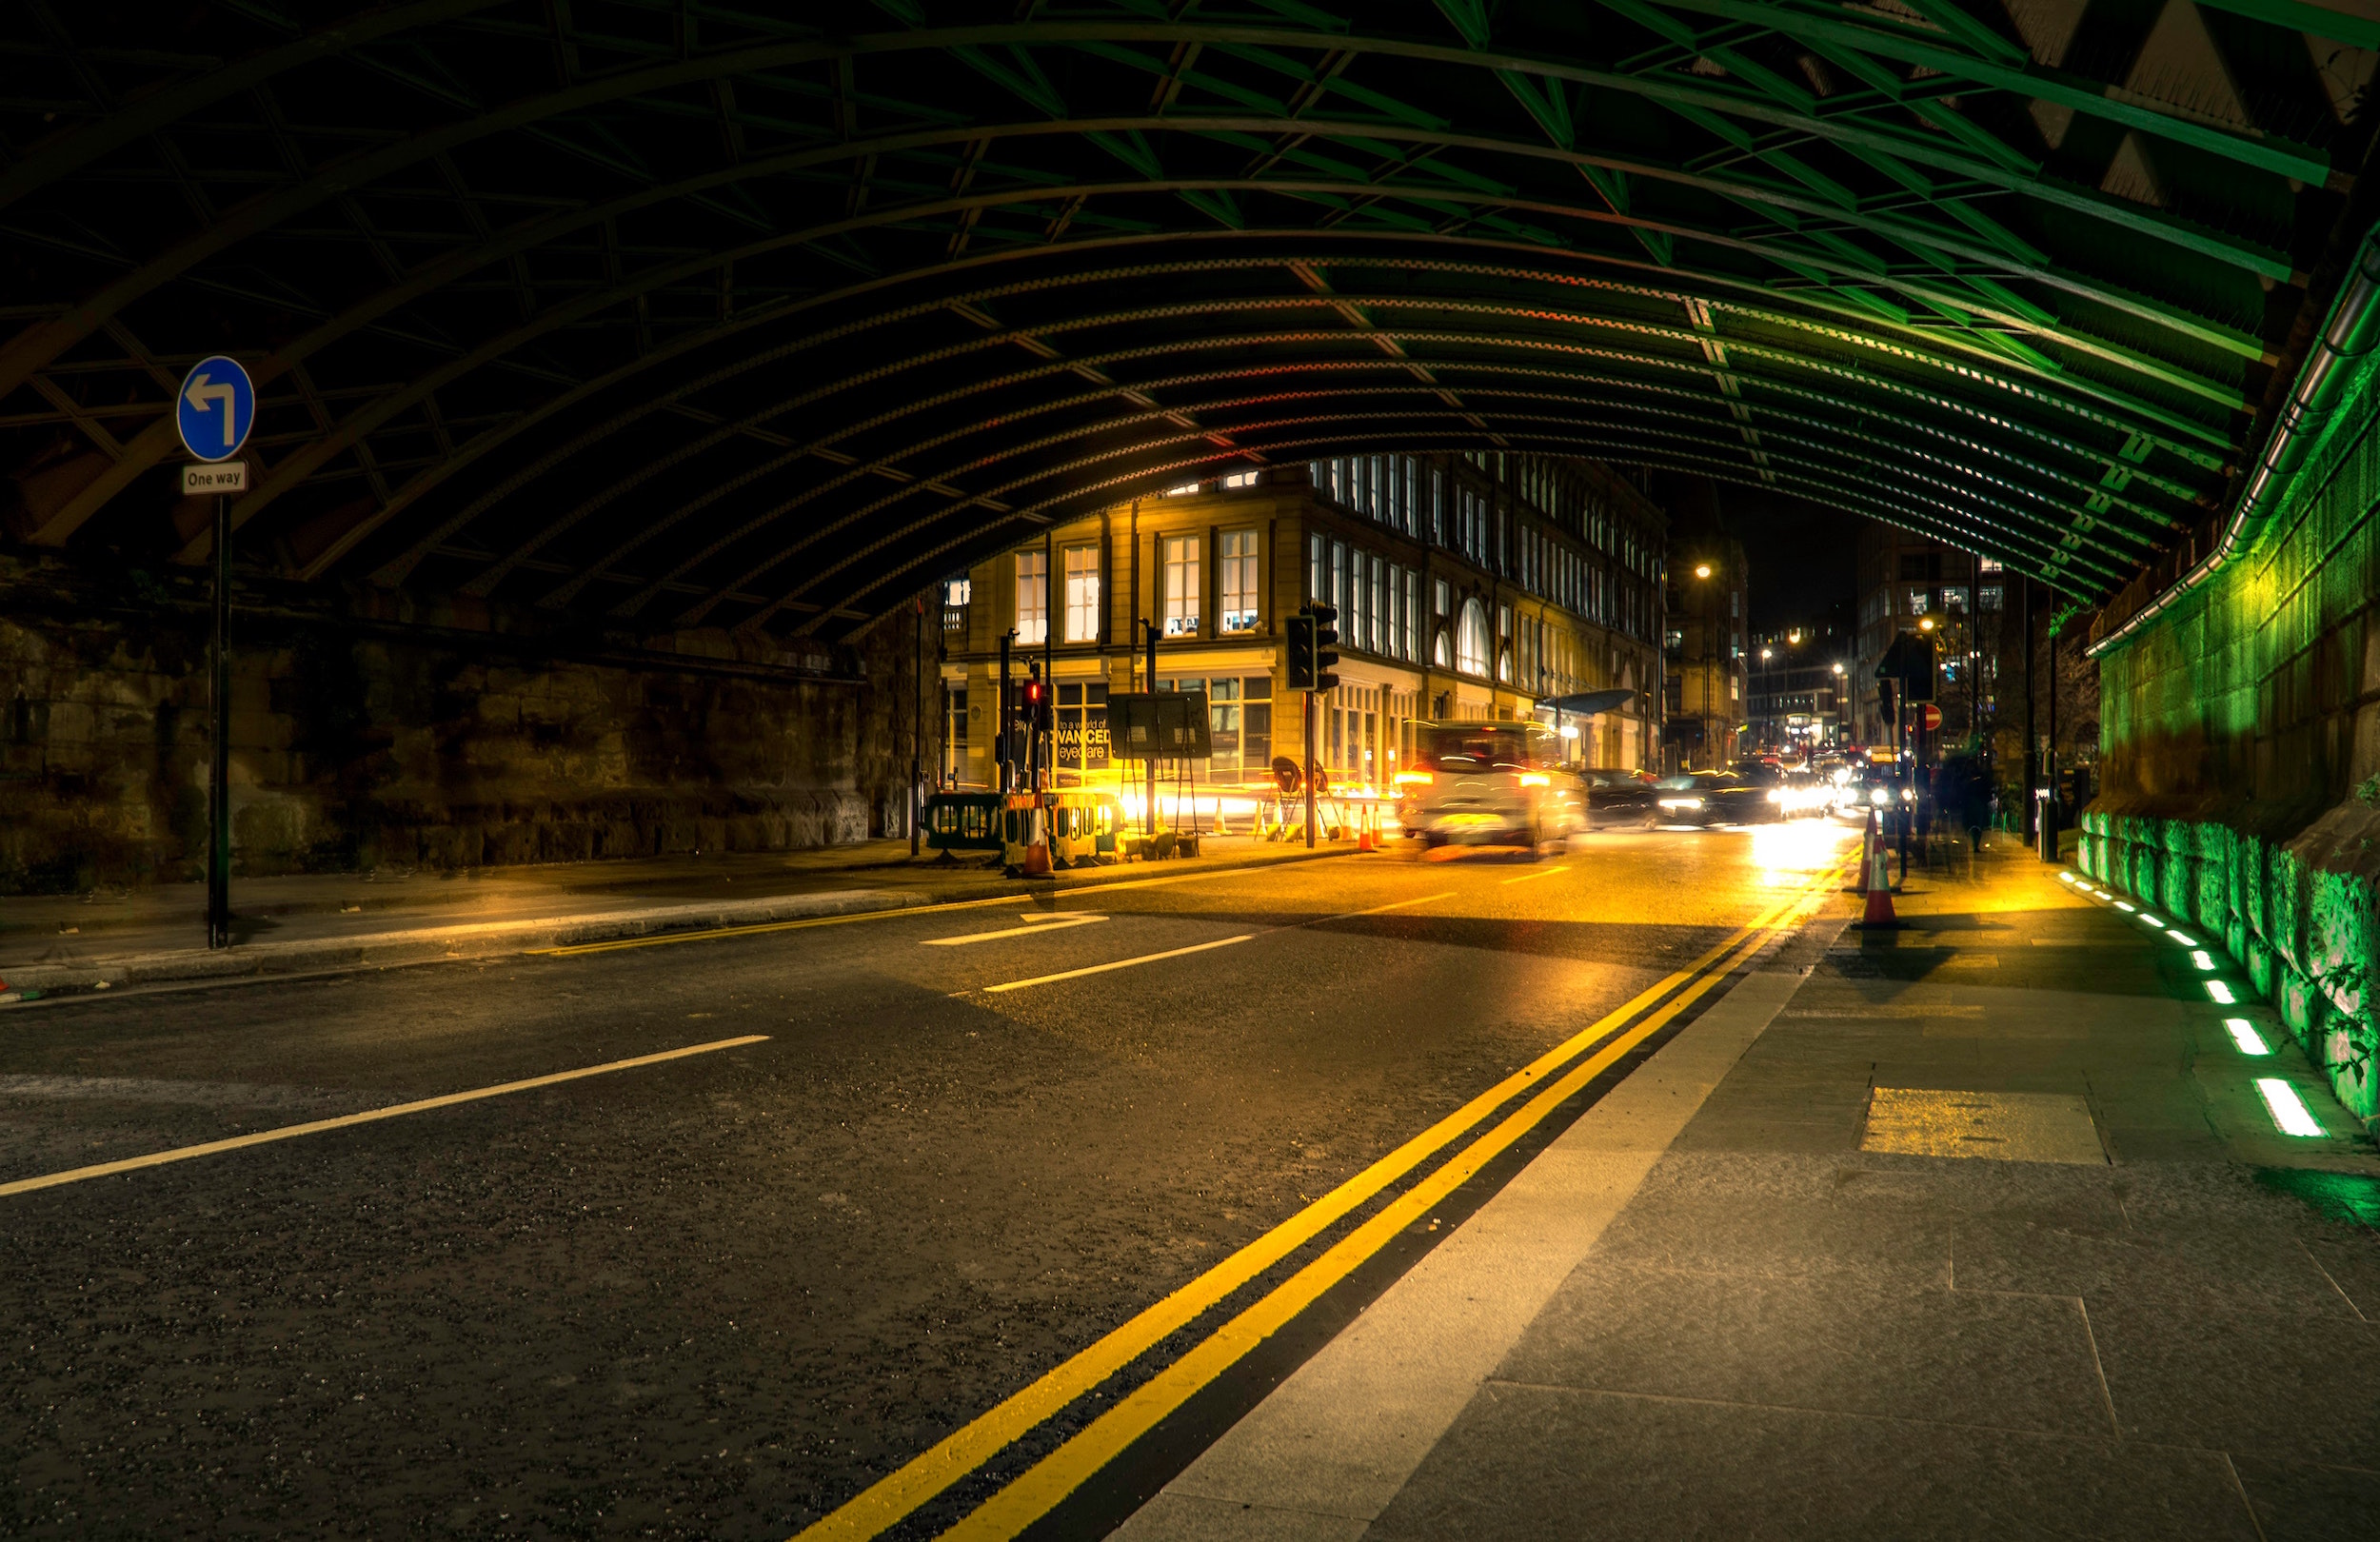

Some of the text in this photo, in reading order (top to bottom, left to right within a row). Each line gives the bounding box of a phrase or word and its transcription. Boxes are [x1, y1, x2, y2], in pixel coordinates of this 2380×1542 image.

[188, 472, 240, 486] One way
[1075, 720, 1097, 729] wrld
[1098, 719, 1106, 729] of
[1039, 729, 1111, 744] AVANCED
